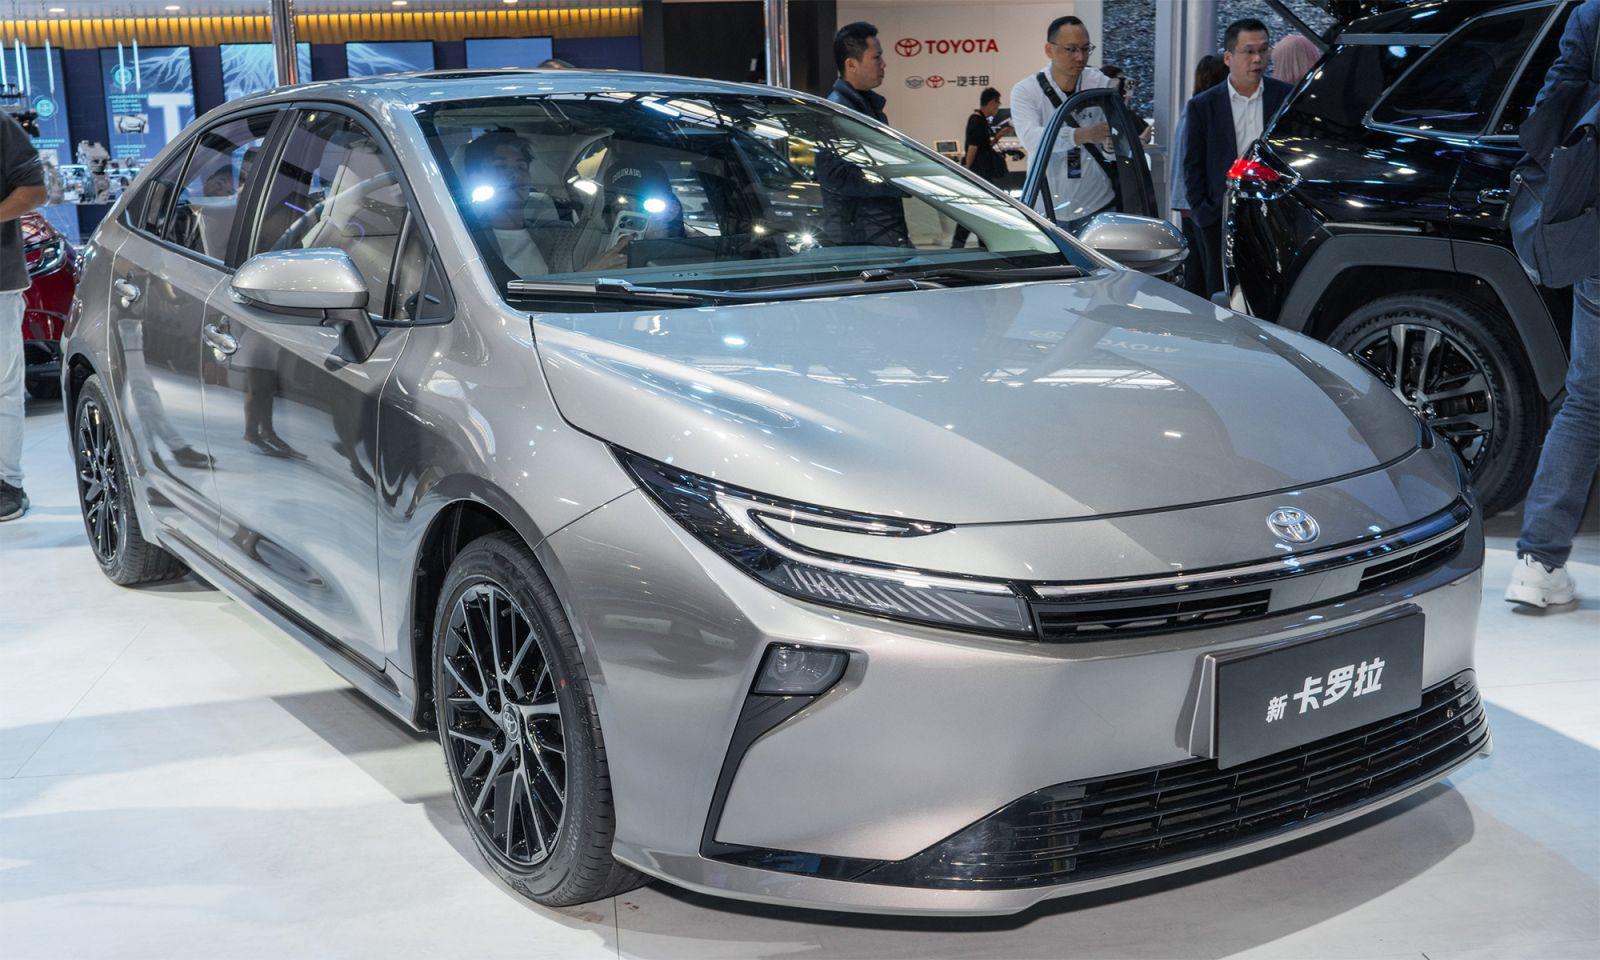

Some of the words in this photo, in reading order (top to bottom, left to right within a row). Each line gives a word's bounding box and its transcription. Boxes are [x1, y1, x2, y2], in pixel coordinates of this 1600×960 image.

[925, 39, 999, 54] TOYOTA
[947, 75, 989, 87] 一汽丰田
